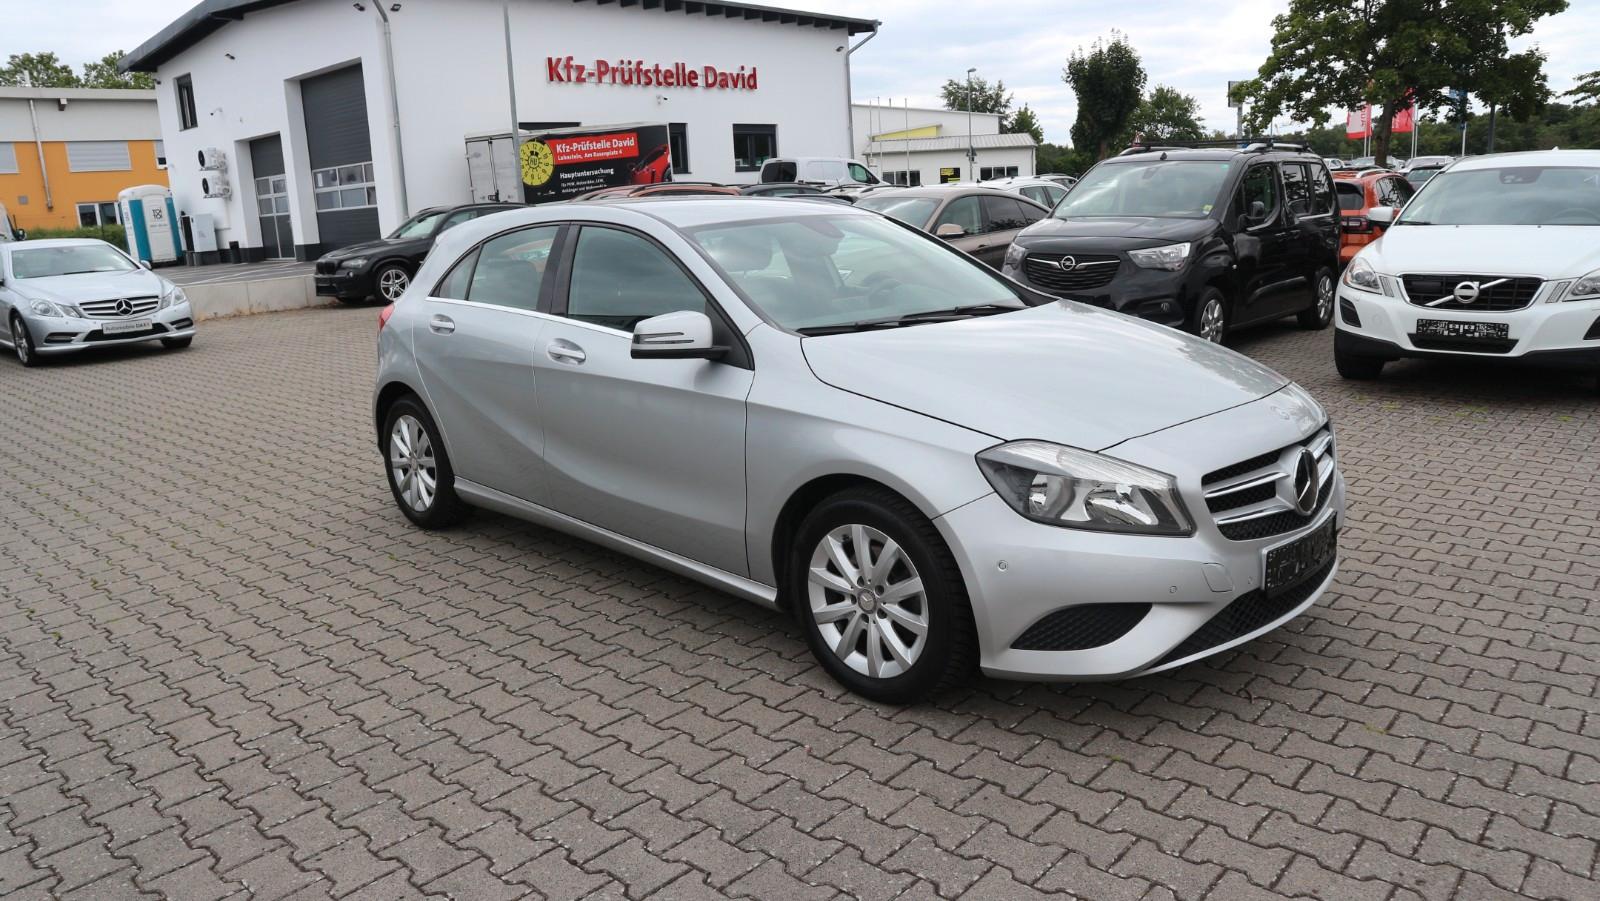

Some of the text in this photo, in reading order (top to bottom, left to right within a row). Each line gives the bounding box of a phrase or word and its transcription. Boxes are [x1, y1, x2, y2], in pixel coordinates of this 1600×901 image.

[547, 56, 758, 90] Kfz-Prüfstelle David
[556, 137, 635, 153] Kfz-Prüfstelle David
[560, 168, 614, 179] Hauptuntersuchung
